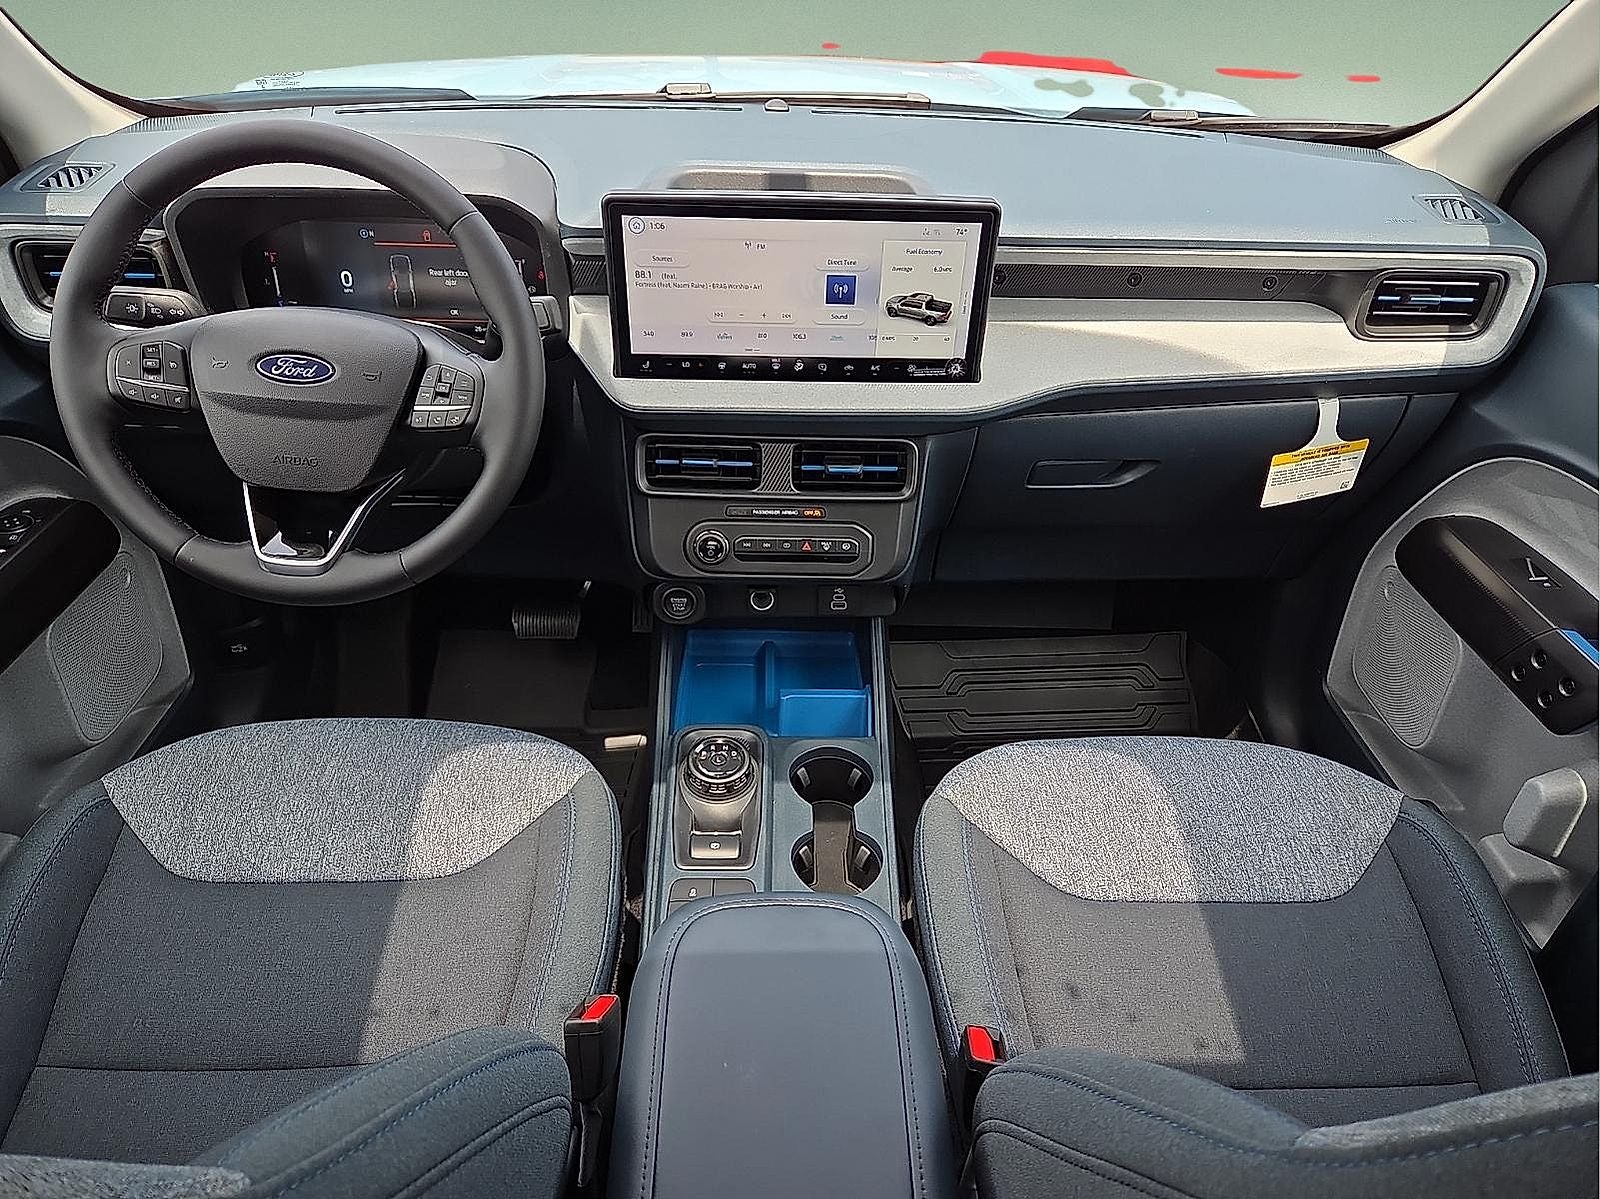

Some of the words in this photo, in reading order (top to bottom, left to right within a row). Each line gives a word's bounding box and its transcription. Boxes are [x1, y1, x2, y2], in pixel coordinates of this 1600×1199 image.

[649, 222, 665, 230] 1:06
[652, 255, 674, 263] Sources
[455, 269, 469, 277] doo
[634, 270, 652, 279] 88.1
[340, 270, 353, 287] 0
[271, 357, 318, 378] Ford
[272, 454, 319, 468] AIRBAG
